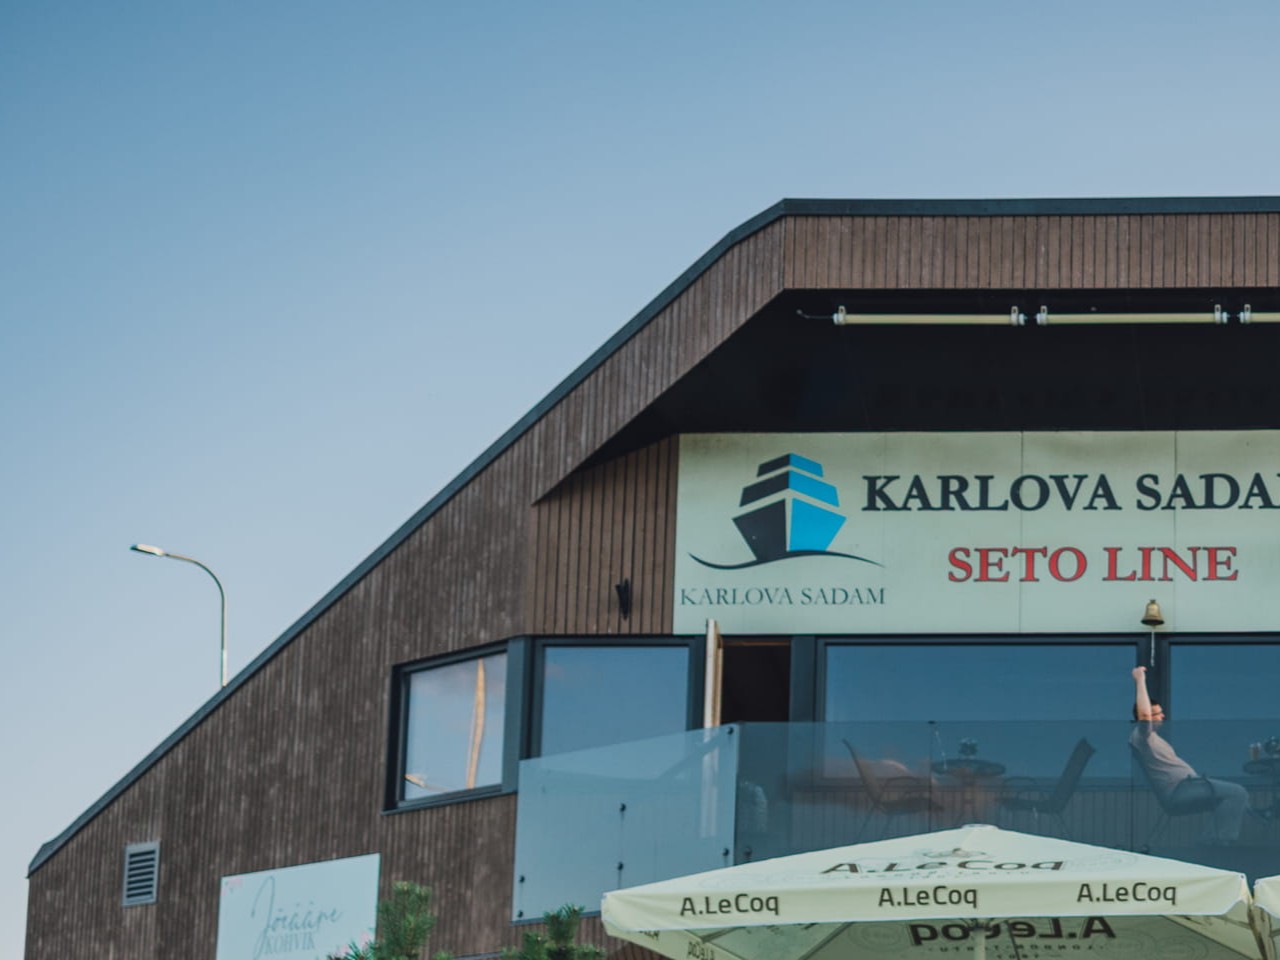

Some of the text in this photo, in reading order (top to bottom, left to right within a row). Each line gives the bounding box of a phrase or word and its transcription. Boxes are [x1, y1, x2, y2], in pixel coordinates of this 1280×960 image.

[861, 474, 1122, 512] KARLOVA
[947, 546, 1239, 583] SETO LINE
[680, 588, 886, 606] KARLOVA SADAM
